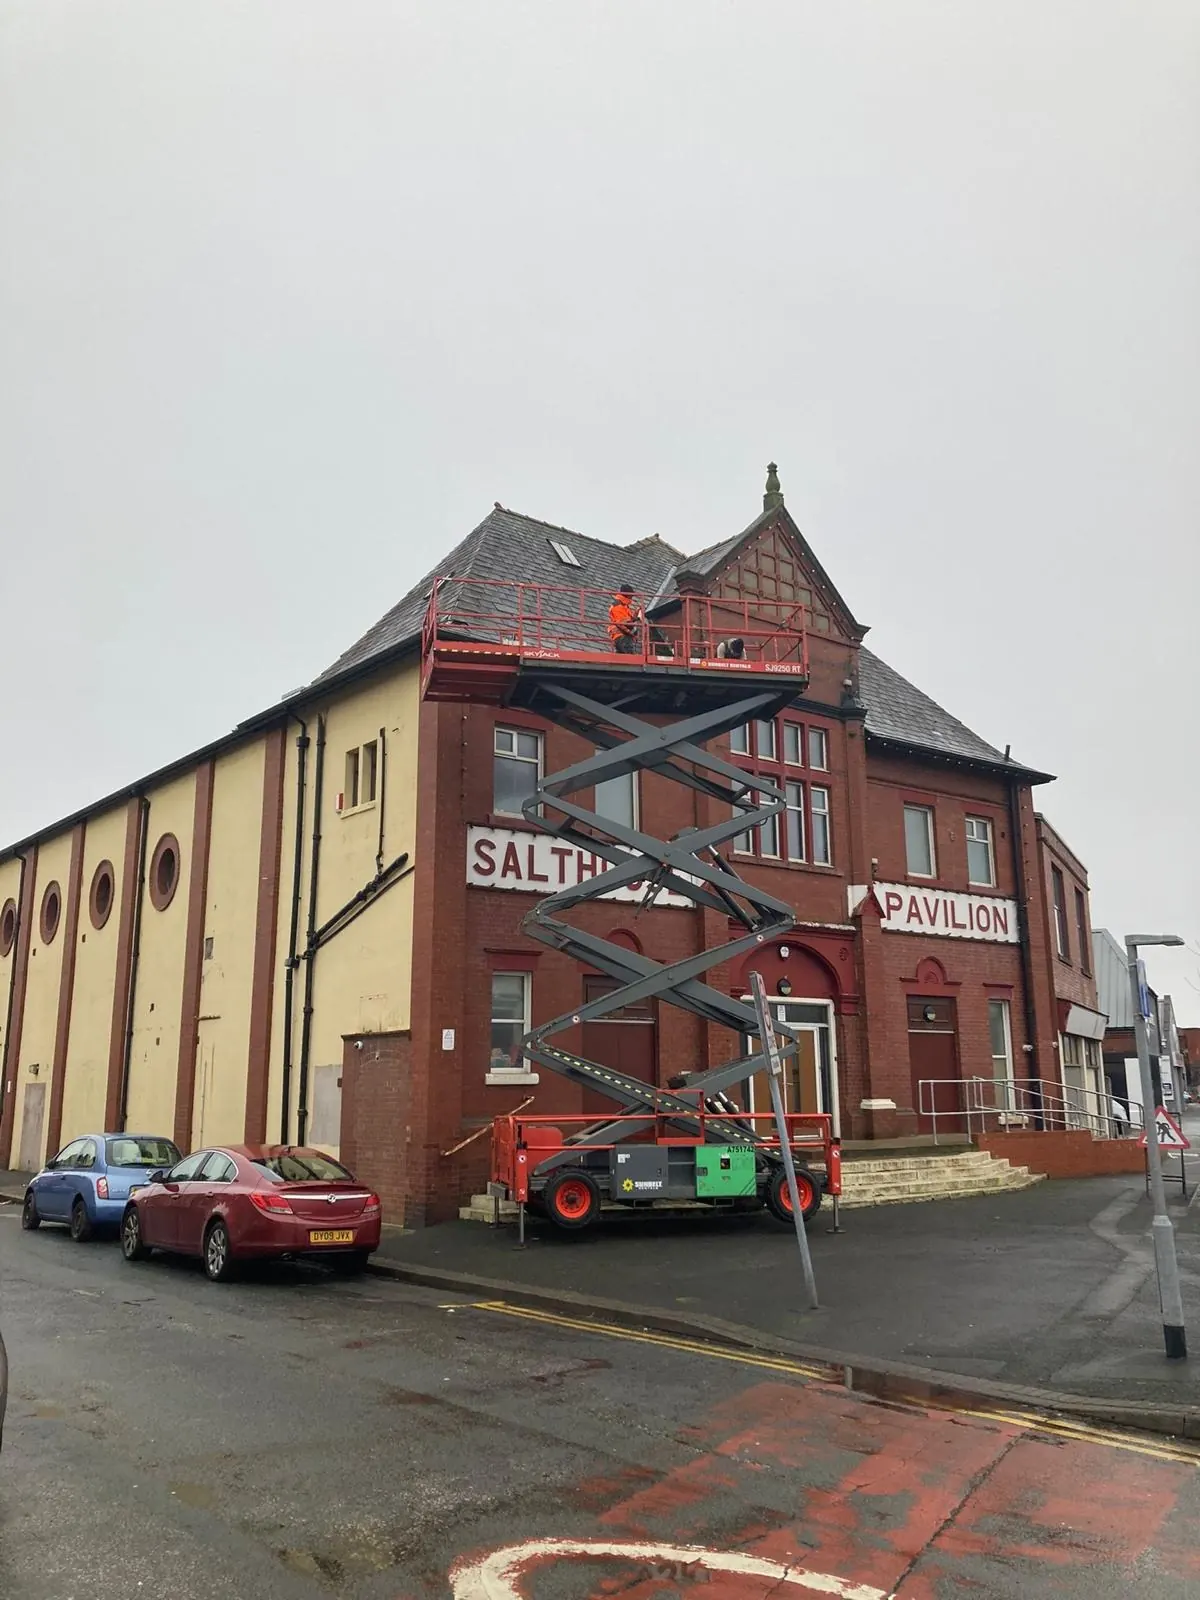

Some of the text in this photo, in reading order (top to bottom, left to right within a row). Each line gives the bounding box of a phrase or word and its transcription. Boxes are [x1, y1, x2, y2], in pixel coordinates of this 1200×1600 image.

[524, 650, 560, 658] SKYJACK
[792, 665, 801, 673] RT
[885, 891, 1009, 935] PAVILION
